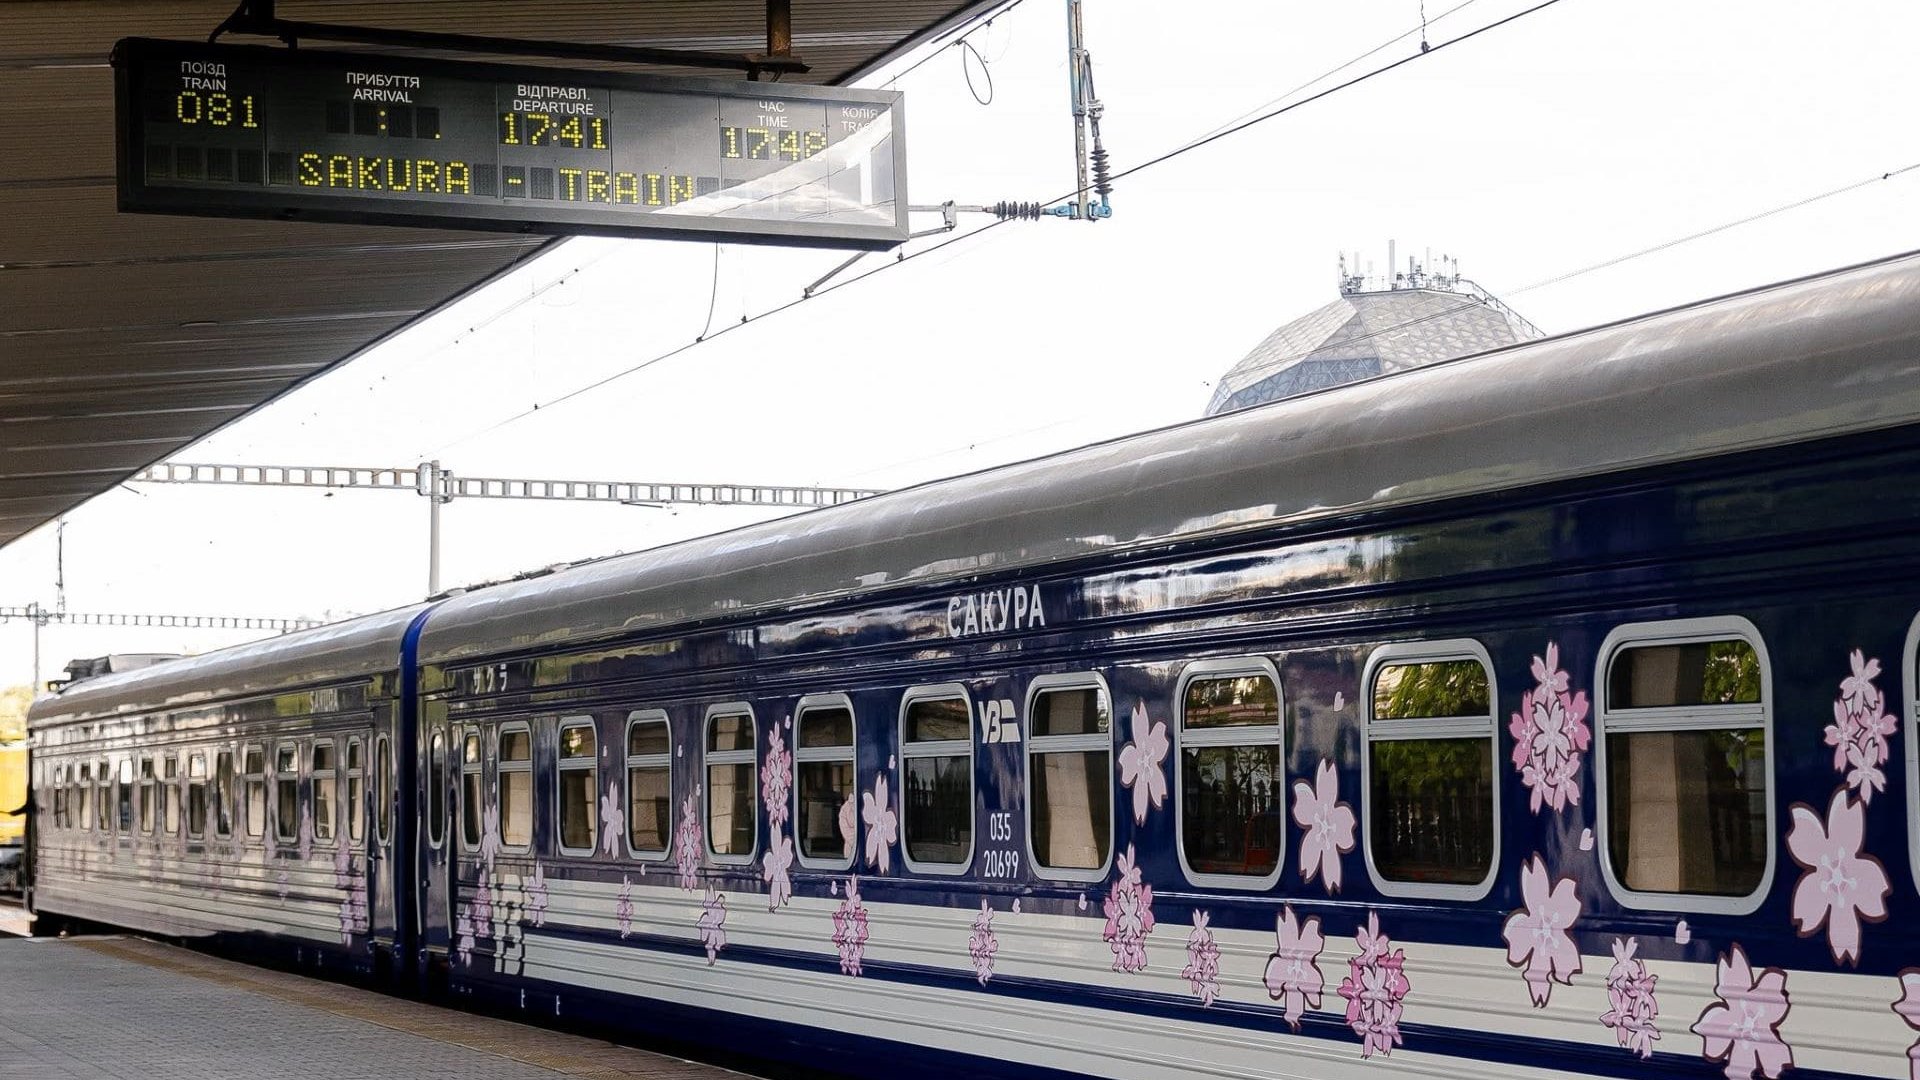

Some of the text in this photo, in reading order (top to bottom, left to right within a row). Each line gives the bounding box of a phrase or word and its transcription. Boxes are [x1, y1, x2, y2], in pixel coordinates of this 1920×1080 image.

[182, 77, 226, 91] TRAIN
[346, 72, 420, 89] ПРИБУТТЯ
[353, 87, 413, 103] ARRIVAL
[517, 84, 591, 101] ВІДПРАВЛ.
[177, 91, 258, 128] 081
[513, 99, 594, 116] DEPARTURE
[758, 101, 785, 113] ЧАС
[842, 105, 878, 119] КОЛІЯ
[757, 115, 789, 128] TIME
[503, 113, 609, 150] 17:41
[299, 153, 470, 194] SAKURA
[559, 169, 694, 206] TRAIN
[947, 583, 1046, 639] САКУРА
[990, 812, 1011, 841] 035
[983, 850, 1019, 879] 20699
